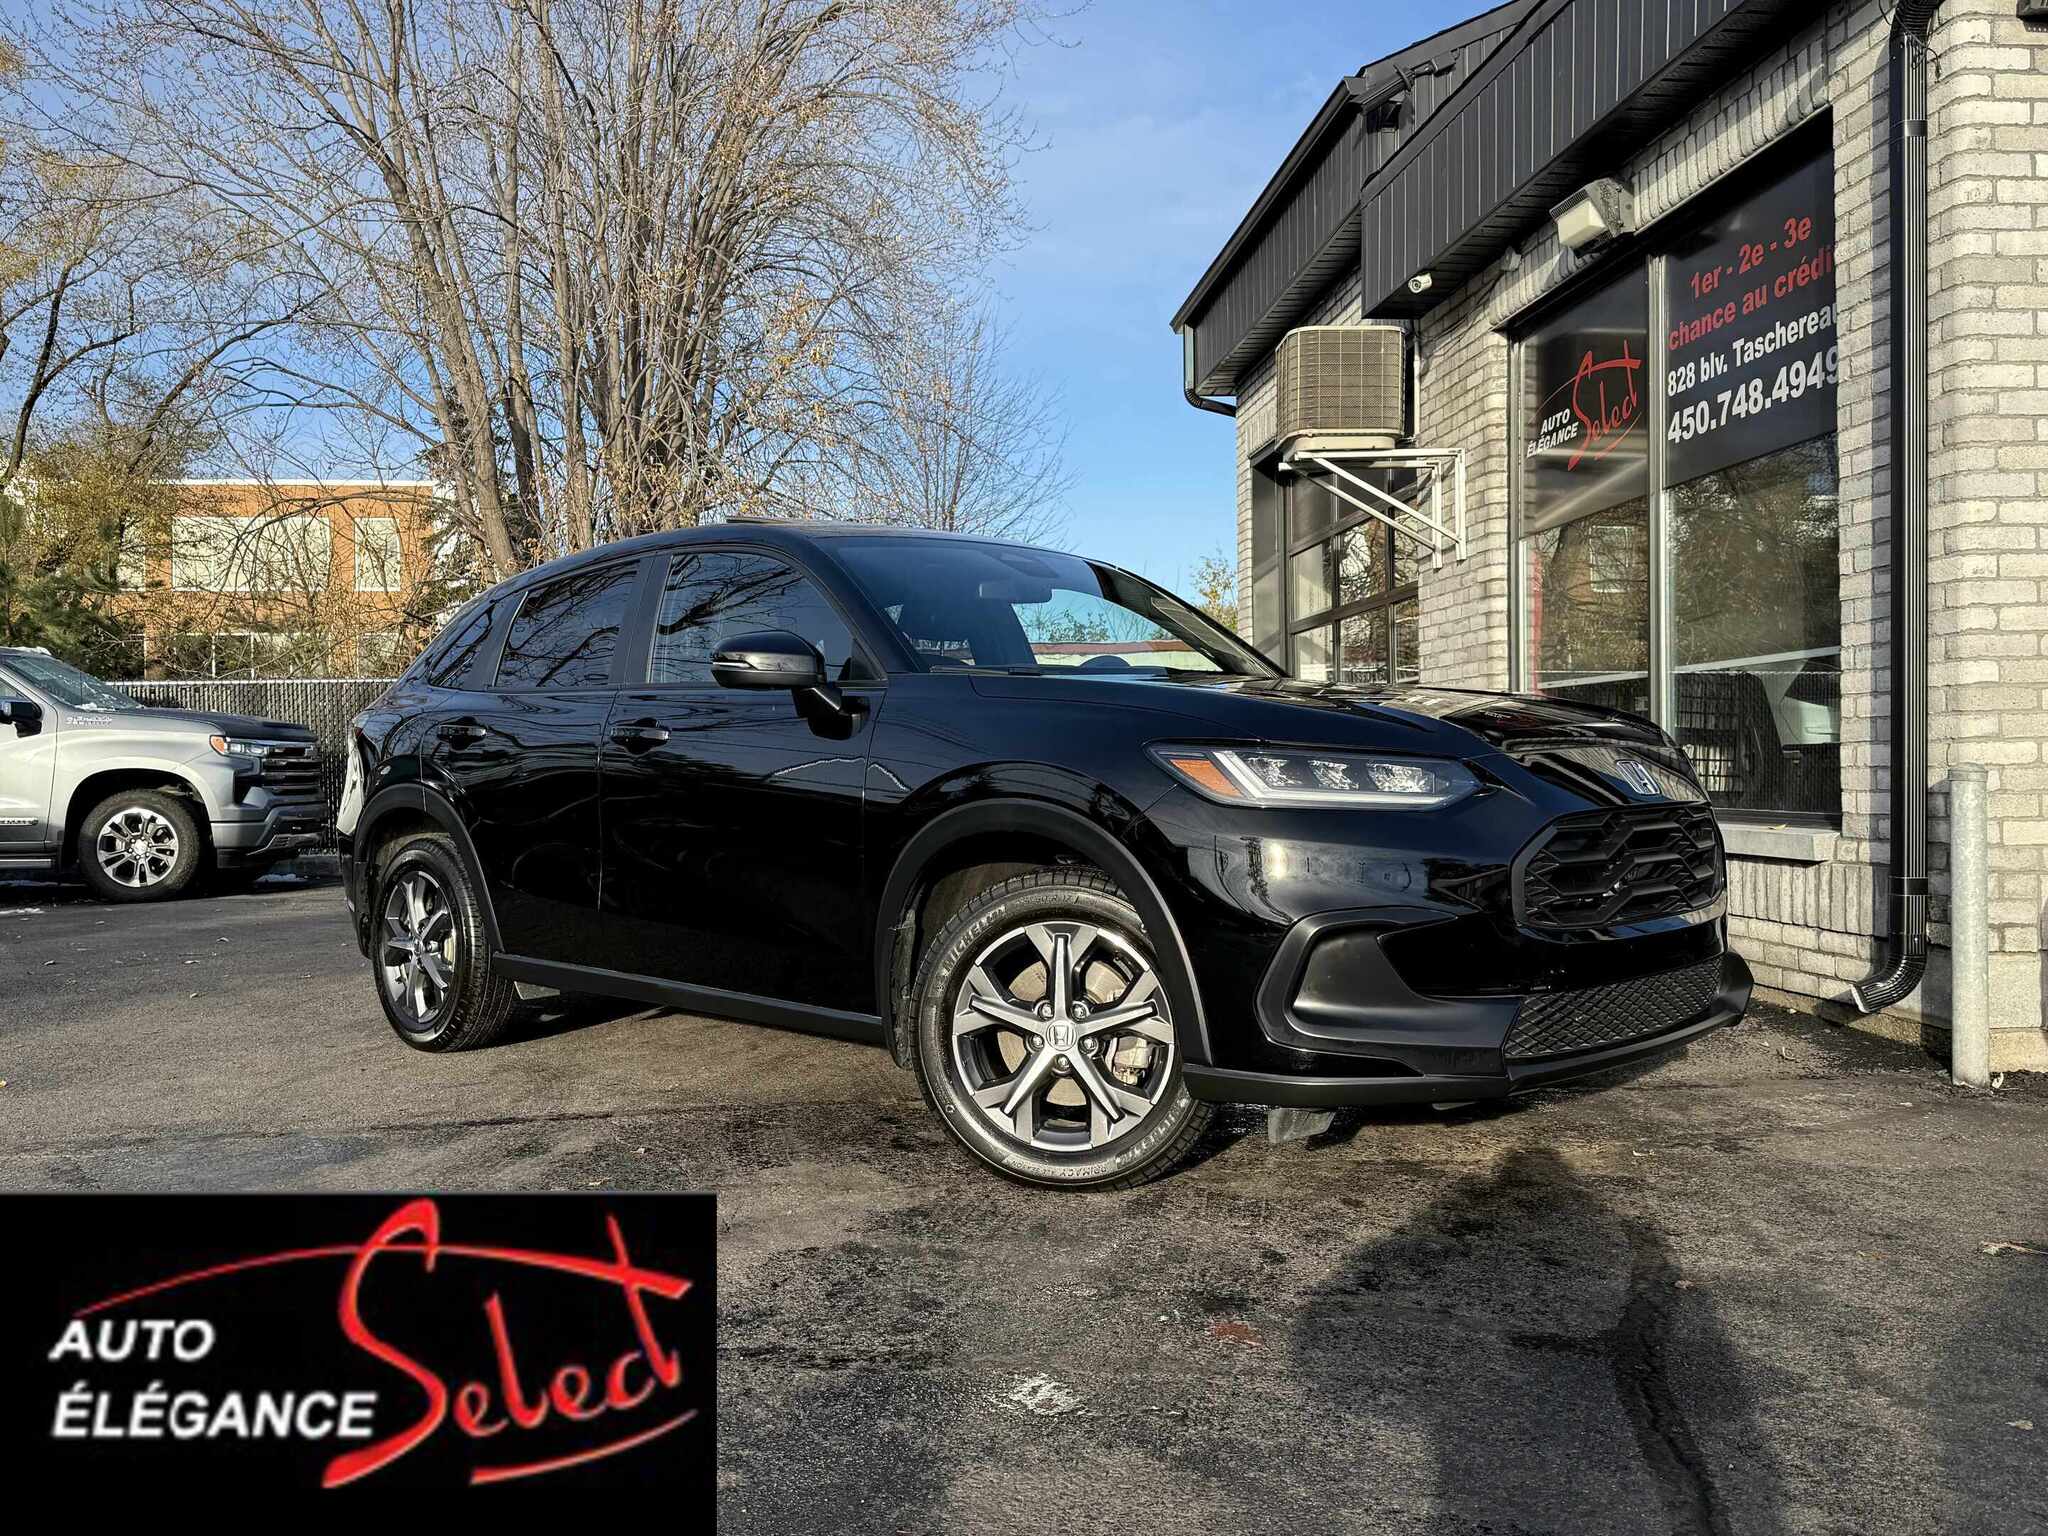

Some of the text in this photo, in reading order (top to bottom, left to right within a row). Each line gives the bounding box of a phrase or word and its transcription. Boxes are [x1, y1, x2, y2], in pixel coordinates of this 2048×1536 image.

[1668, 244, 1835, 350] chance au crédi
[1690, 264, 1722, 299] 1er
[1738, 243, 1765, 275] 2e
[1783, 215, 1812, 249] 3e
[1568, 339, 1642, 471] Select
[1667, 361, 1696, 397] 828
[1700, 352, 1728, 383] blv.
[1667, 345, 1839, 443] 450.748.4949
[1526, 421, 1579, 458] ÉLÉGANCE
[1540, 408, 1571, 435] AUTO
